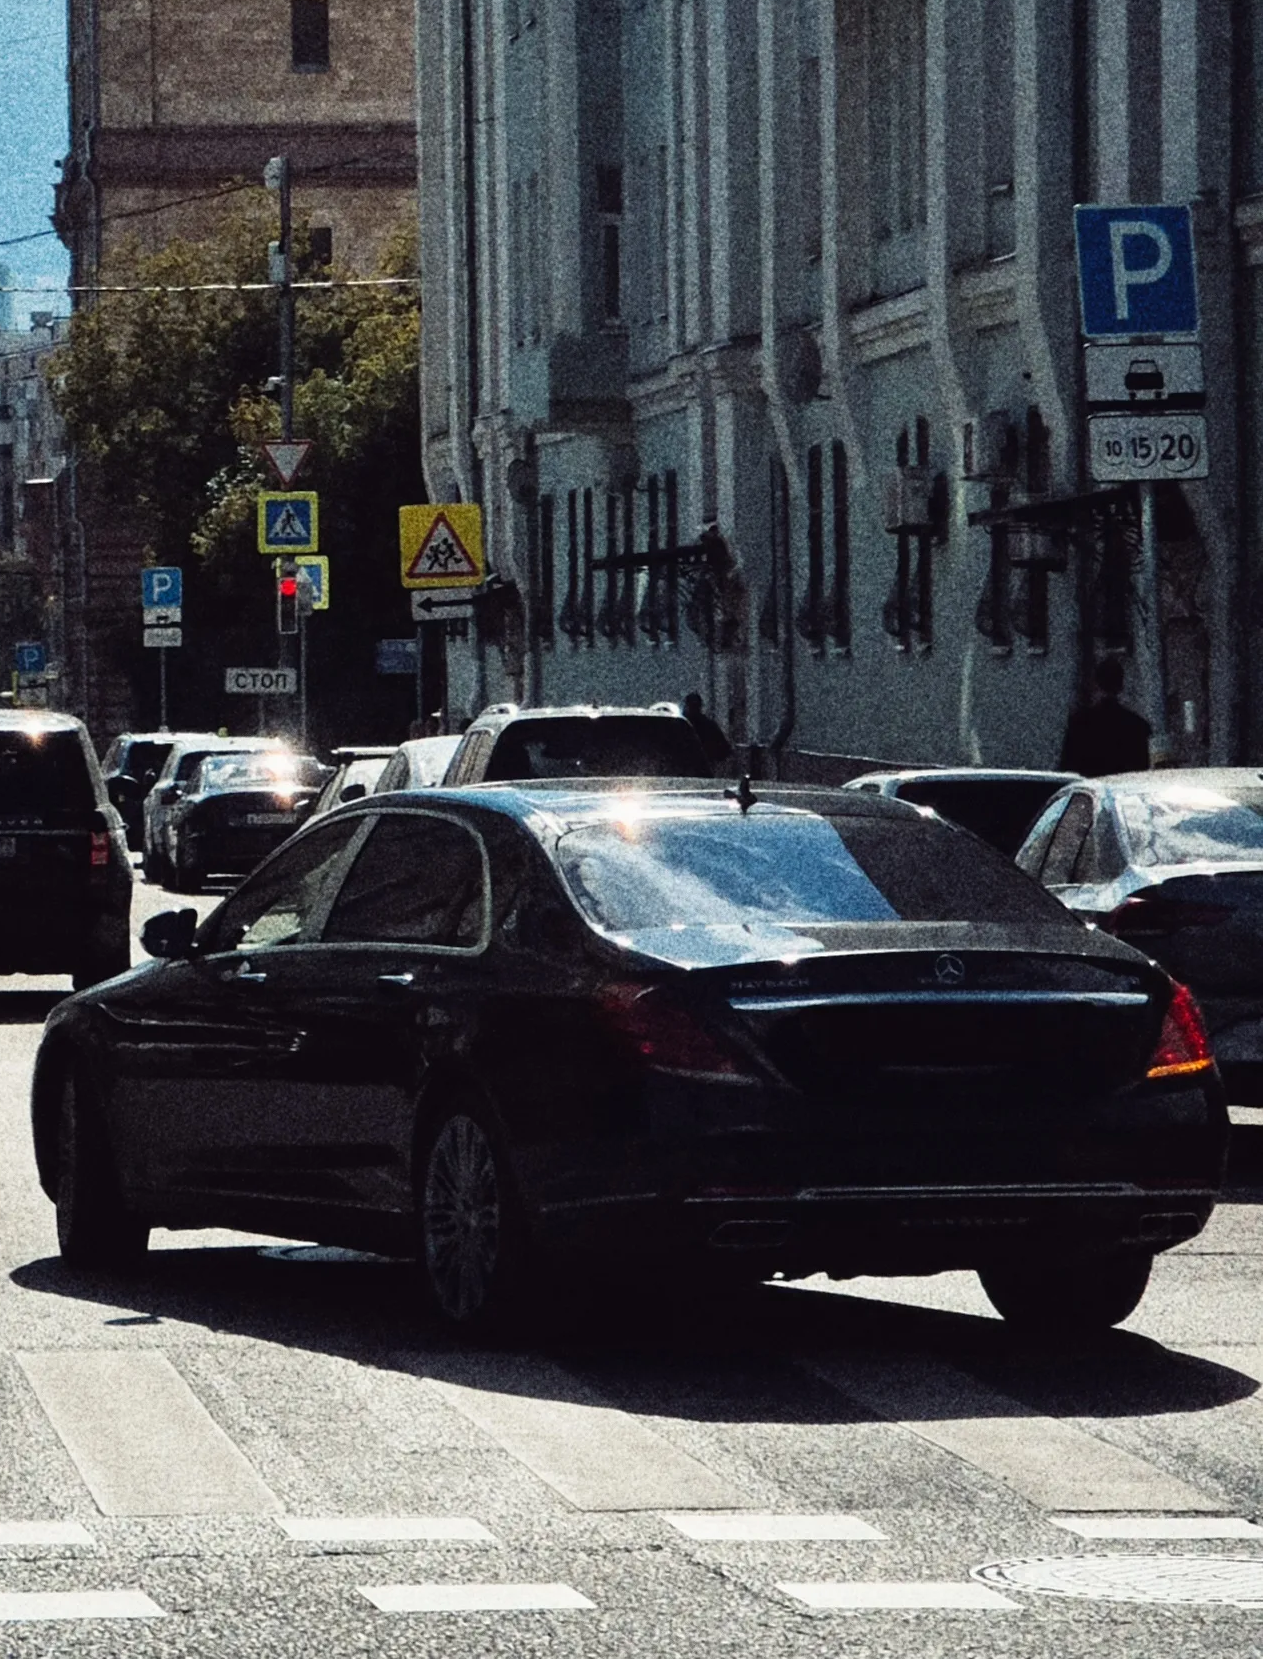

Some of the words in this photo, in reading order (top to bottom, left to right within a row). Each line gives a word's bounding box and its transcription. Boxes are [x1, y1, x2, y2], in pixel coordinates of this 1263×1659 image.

[1108, 220, 1173, 321] P
[1105, 439, 1123, 456] 10
[1131, 437, 1153, 460] 15
[1160, 433, 1195, 461] 20
[152, 573, 173, 603] P
[23, 648, 39, 670] P
[235, 672, 289, 689] СТОП
